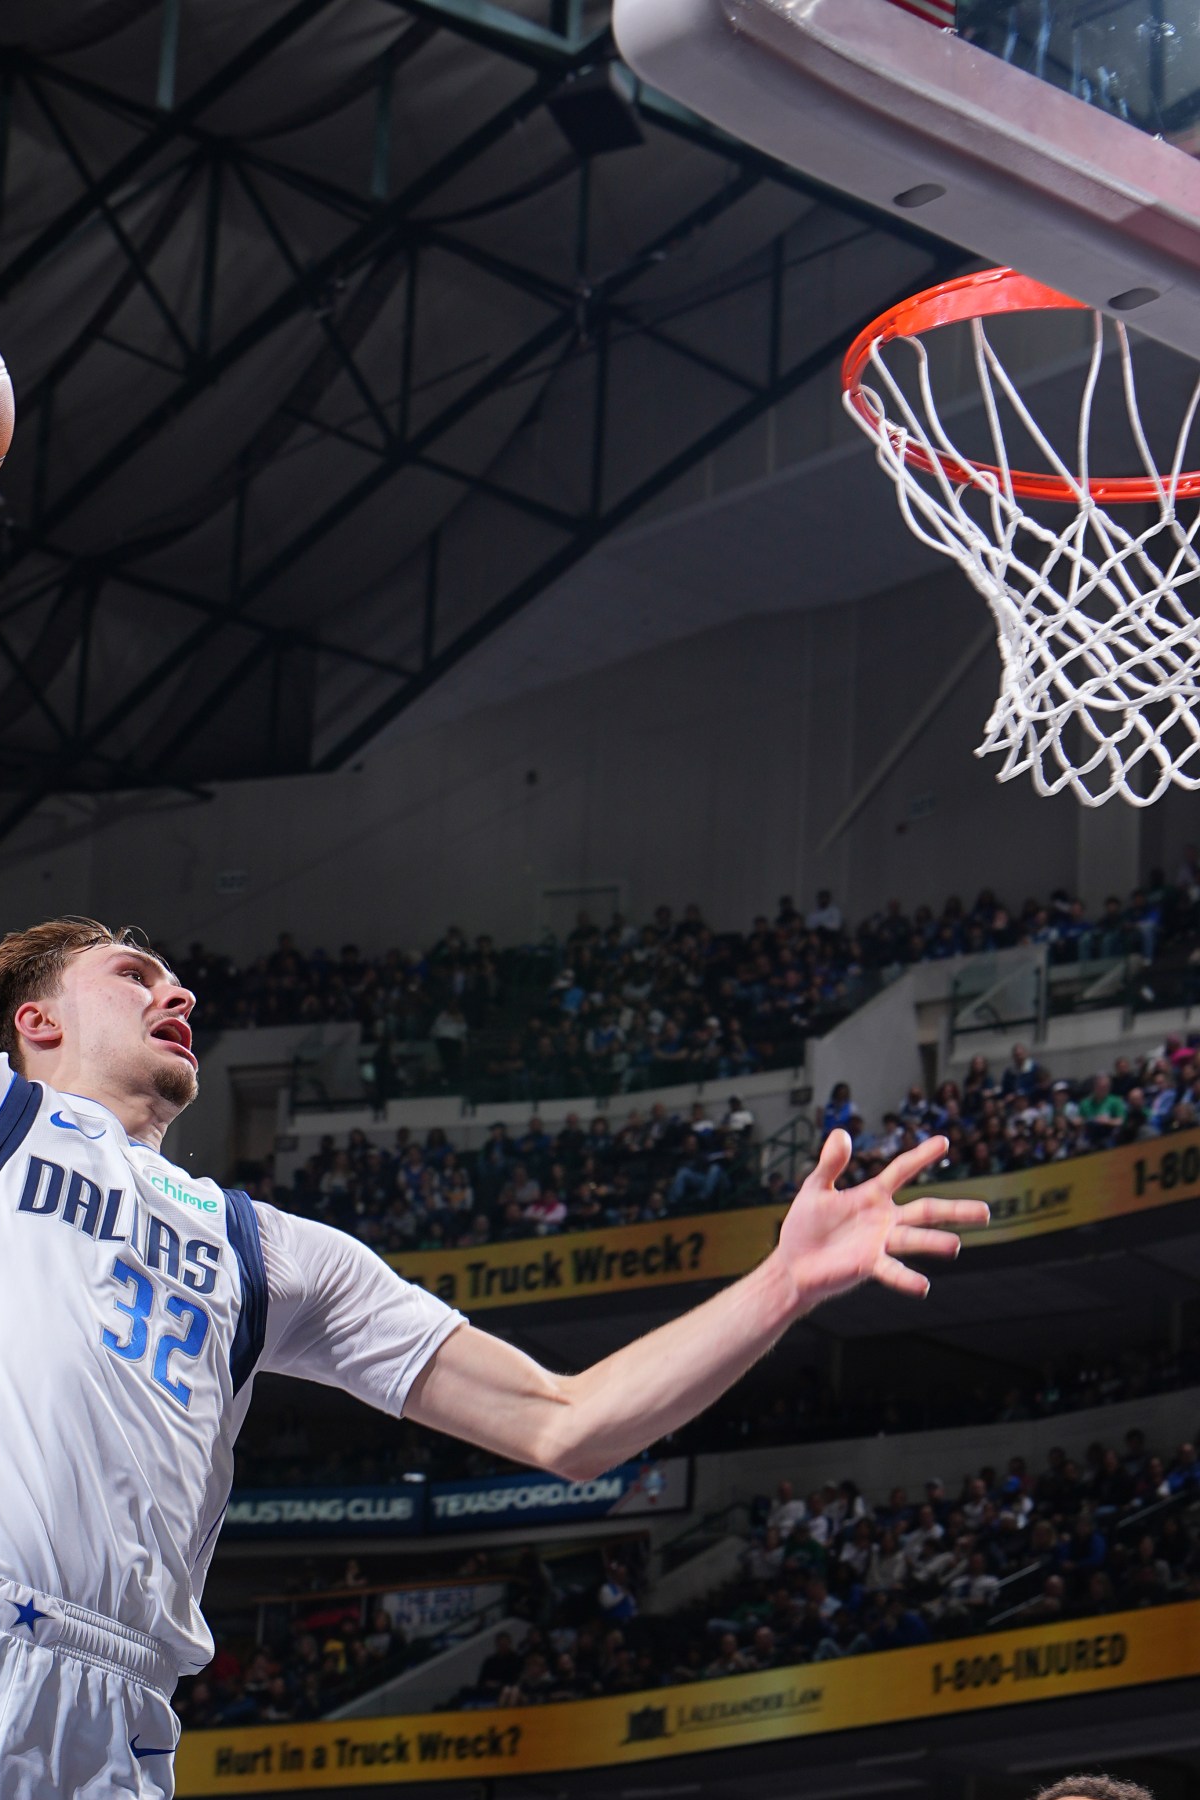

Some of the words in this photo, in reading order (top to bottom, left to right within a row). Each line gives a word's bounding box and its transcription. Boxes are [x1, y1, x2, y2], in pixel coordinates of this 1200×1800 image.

[151, 1174, 219, 1214] chime
[17, 1154, 223, 1296] DALLAS
[467, 1252, 563, 1298] Truck
[573, 1233, 704, 1284] Wreck?
[101, 1257, 210, 1411] 32
[228, 1498, 345, 1523] MUSTANG
[346, 1495, 414, 1521] CLUB
[432, 1478, 624, 1519] TEXASFORD.COM
[932, 1632, 1126, 1693] 1-800-INJURED
[215, 1746, 272, 1777] Hurt
[280, 1741, 304, 1771] in
[313, 1746, 326, 1769] a
[334, 1735, 409, 1769] Truck
[417, 1726, 522, 1763] Wreck?
